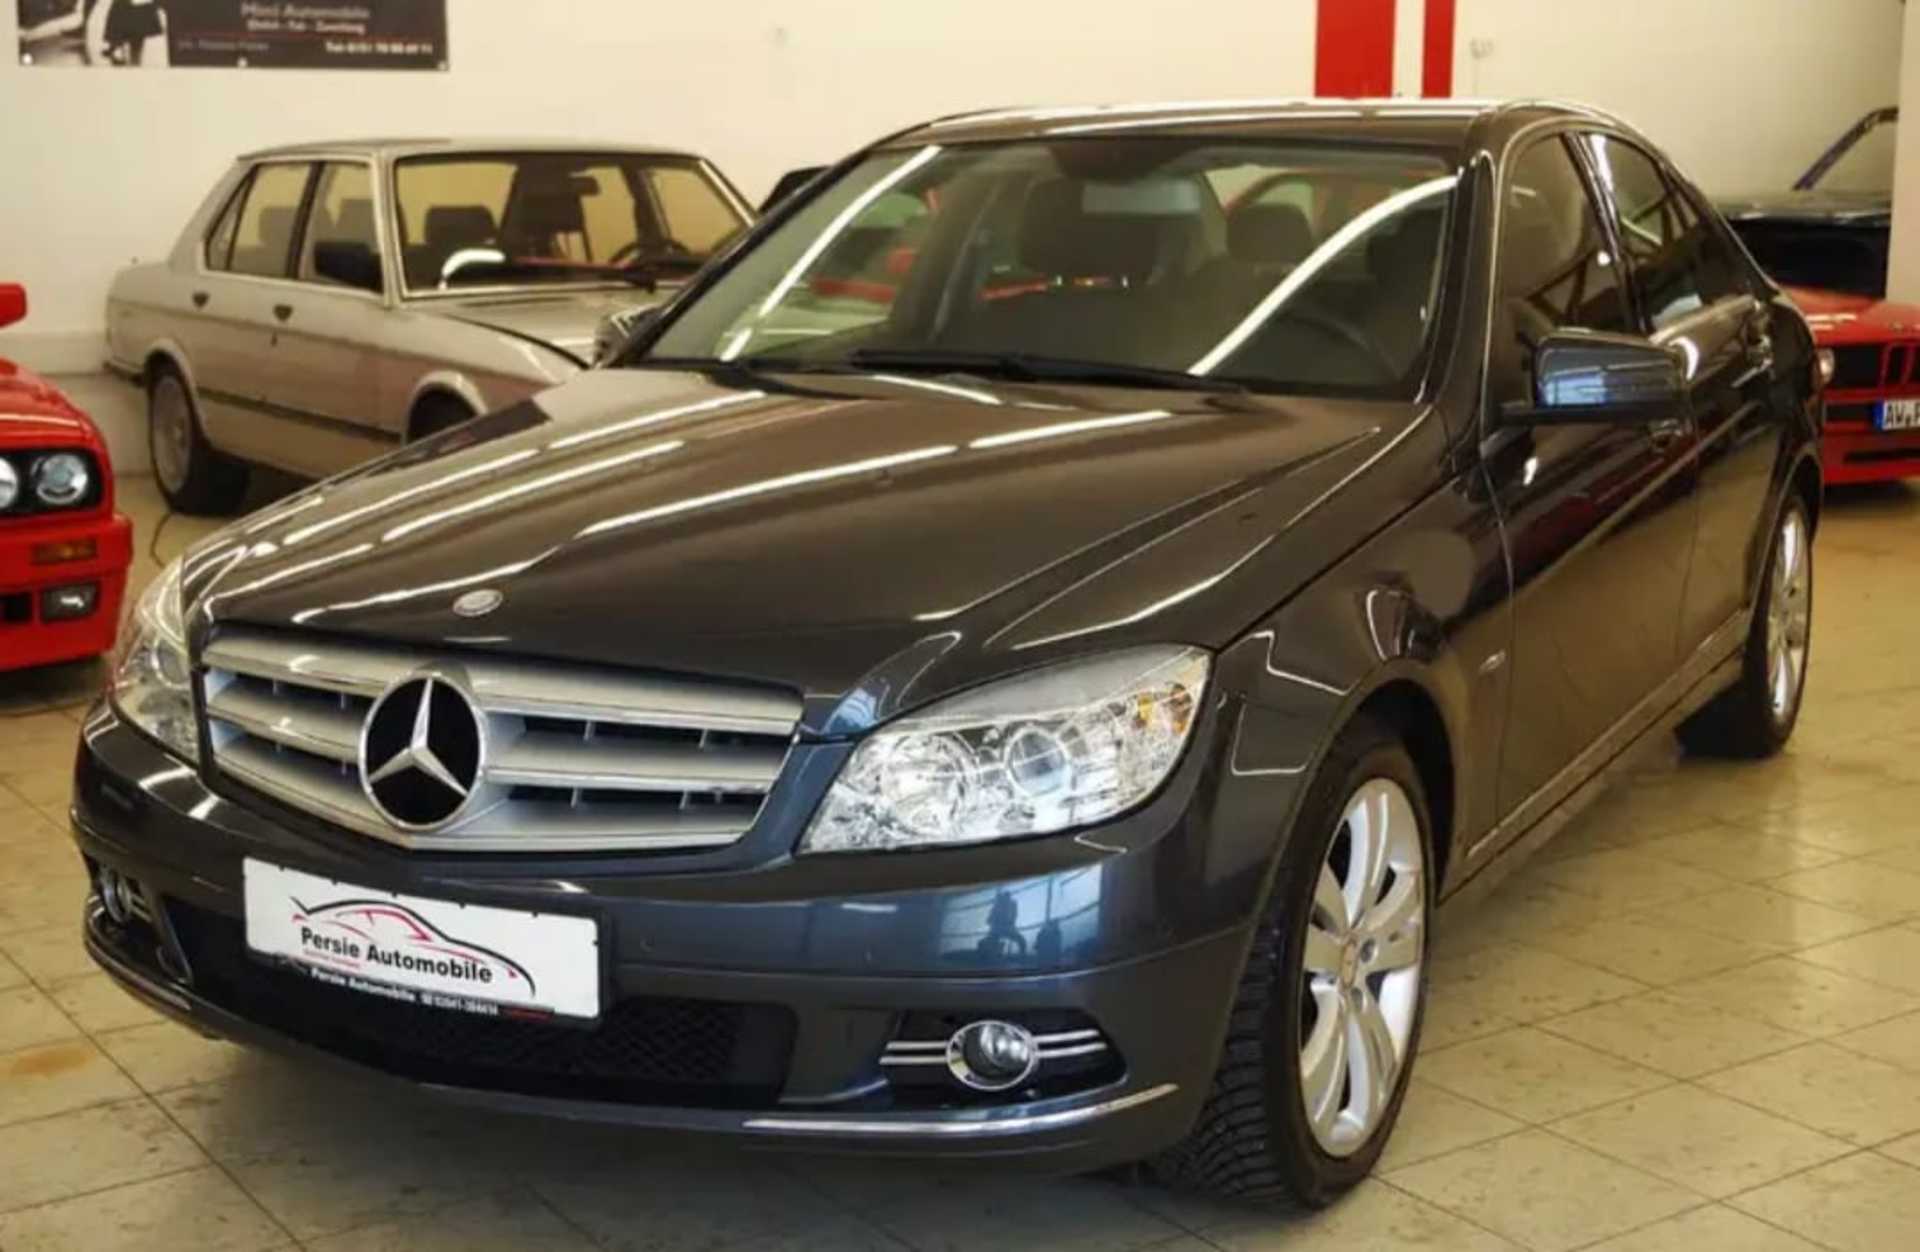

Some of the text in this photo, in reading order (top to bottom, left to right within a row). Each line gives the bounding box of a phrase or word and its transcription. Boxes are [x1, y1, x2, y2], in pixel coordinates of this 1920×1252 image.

[301, 926, 360, 958] Persie
[367, 943, 493, 983] Automobile
[311, 967, 347, 986] Persie
[348, 976, 416, 1001] Automobile
